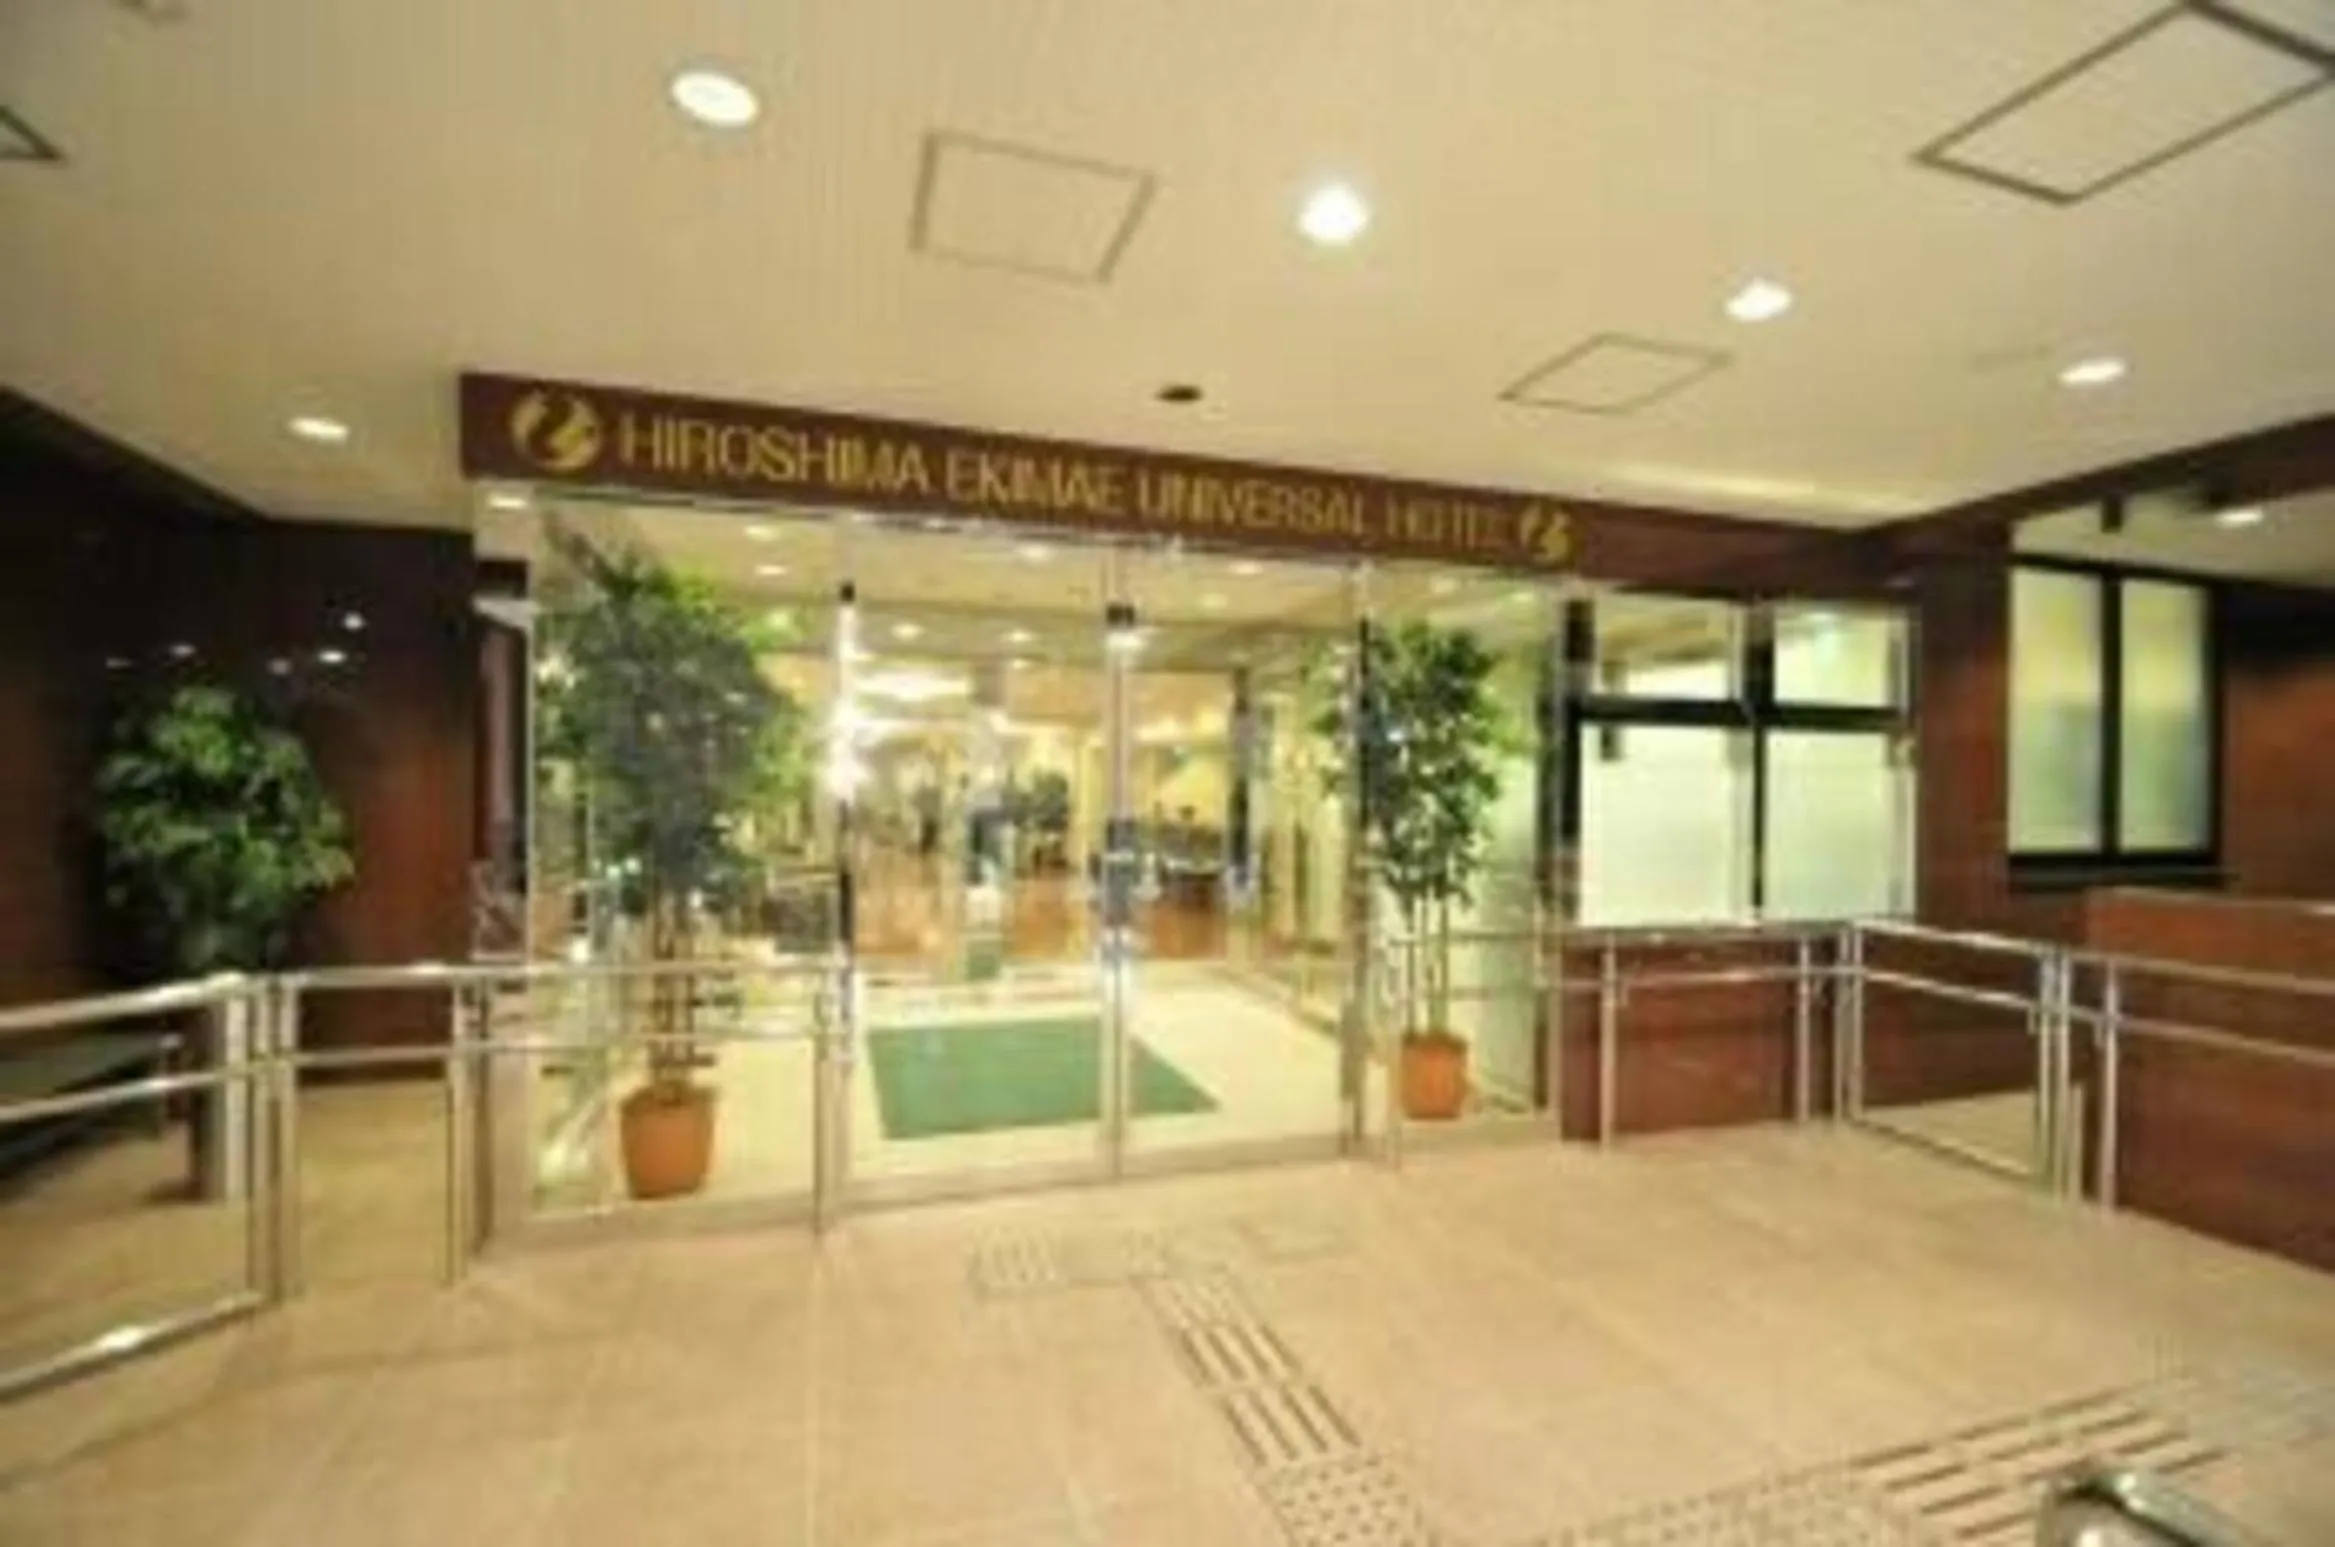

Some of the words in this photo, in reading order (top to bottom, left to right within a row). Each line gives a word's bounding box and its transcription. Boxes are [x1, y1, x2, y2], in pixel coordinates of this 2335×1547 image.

[619, 413, 931, 493] HIROSHIMA
[946, 450, 1125, 515] EKIMAE
[1138, 467, 1367, 536] UNIVERSAL
